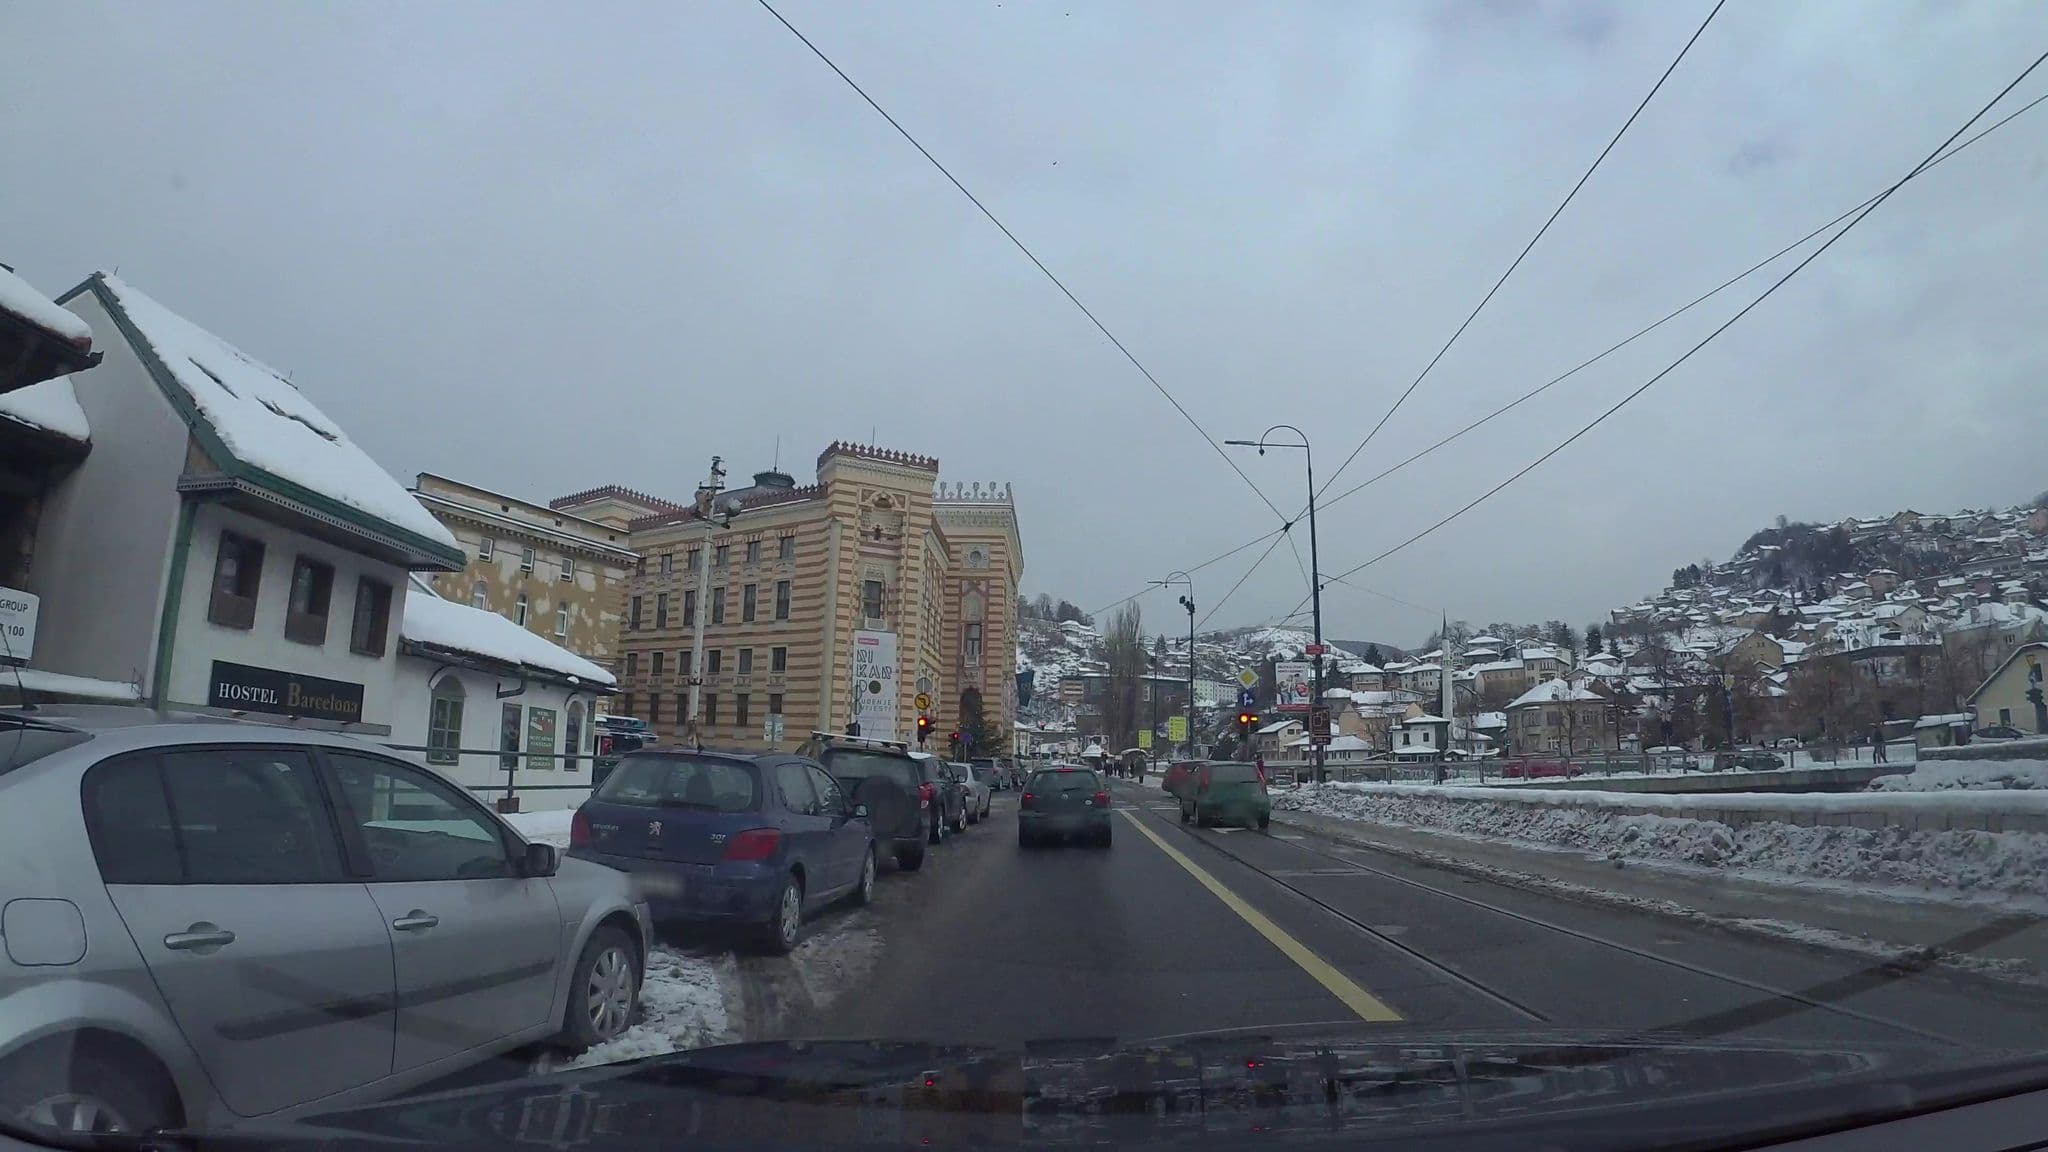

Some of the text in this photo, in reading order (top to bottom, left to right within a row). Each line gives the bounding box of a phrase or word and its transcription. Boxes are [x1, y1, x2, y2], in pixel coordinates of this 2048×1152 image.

[0, 599, 28, 613] GROUP
[8, 625, 25, 637] 100
[218, 682, 358, 713] HOSTEL Barcelona
